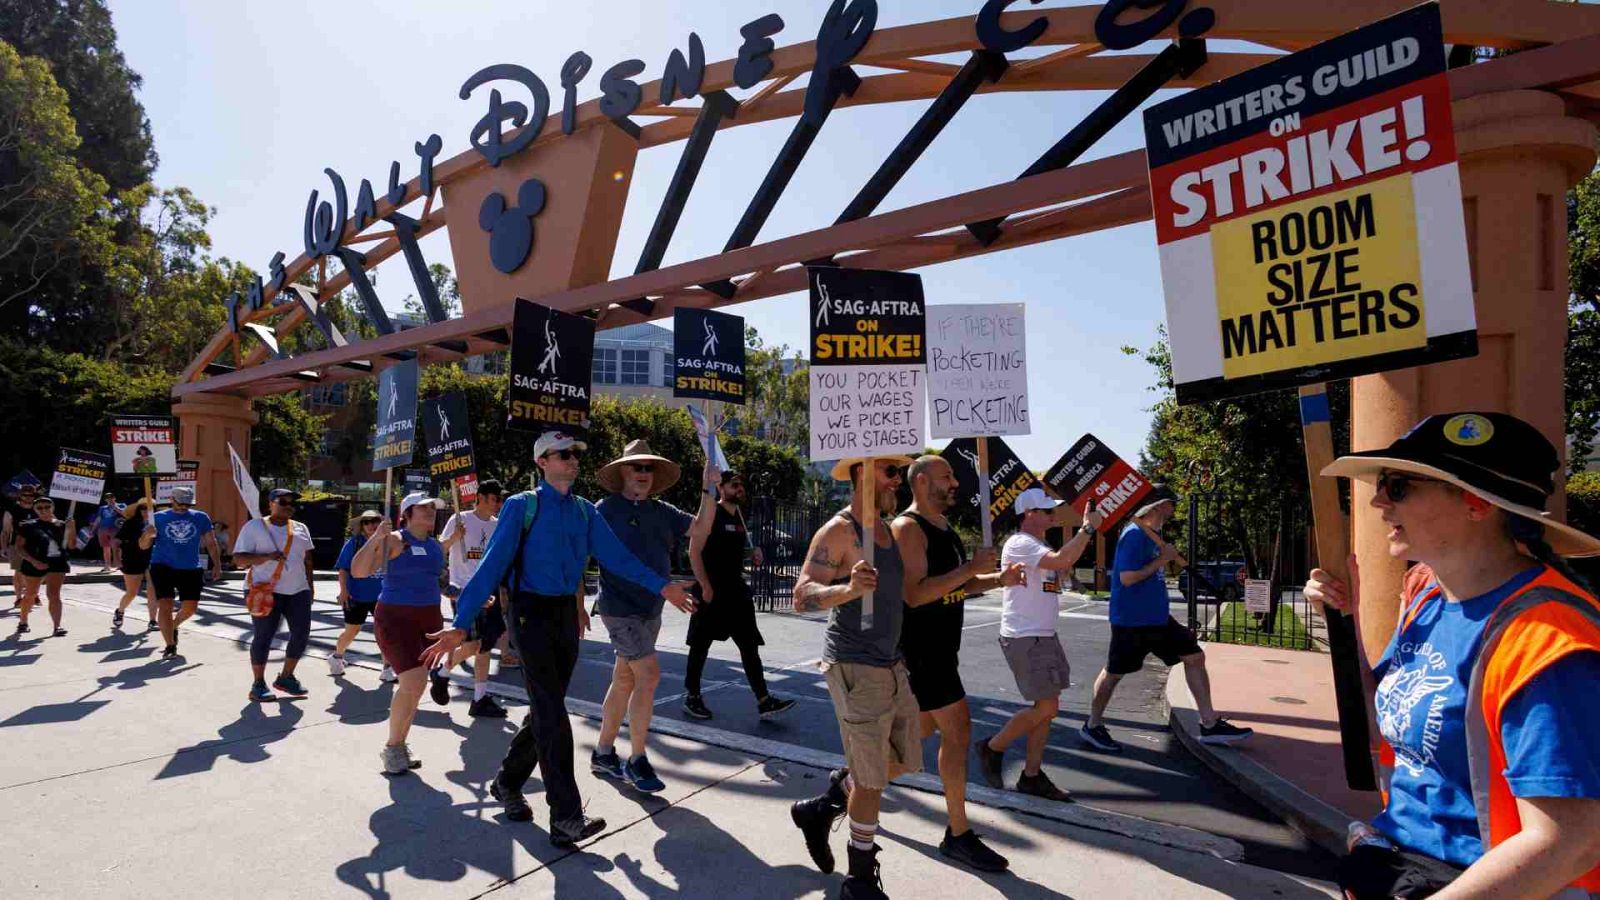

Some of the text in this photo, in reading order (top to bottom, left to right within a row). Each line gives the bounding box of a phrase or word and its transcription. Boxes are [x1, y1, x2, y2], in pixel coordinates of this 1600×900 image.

[1162, 36, 1421, 149] WRITERS GUILD
[1269, 111, 1300, 138] ON
[1169, 94, 1432, 228] STRIKE!
[1251, 193, 1377, 264] ROOM
[1266, 247, 1362, 307] SIZE
[855, 319, 878, 333] ON
[938, 313, 1020, 342] IF THEY'RE
[1220, 282, 1421, 359] MATTERS
[815, 333, 921, 359] STRIKE!
[931, 343, 1024, 373] POCKETING
[676, 376, 743, 396] STRIKE!
[704, 370, 718, 379] ON
[816, 370, 920, 390] YOU POCKET
[540, 395, 556, 405] ON
[819, 391, 913, 412] OUR WAGES
[933, 394, 1028, 427] PICKETING
[511, 400, 587, 425] STRIKE!
[827, 410, 914, 430] WE PICKET
[116, 430, 171, 442] STRIKE!
[817, 428, 919, 451] YOUR STAGES
[373, 440, 412, 461] STRIKE!
[58, 464, 105, 479] STRIKE!
[430, 455, 472, 476] STRIKE!
[1048, 440, 1097, 487] WRITERS GUILD
[1073, 462, 1105, 493] AMERICA
[1094, 480, 1111, 497] ON
[994, 484, 1006, 497] ON
[1096, 472, 1144, 519] TRIKE!
